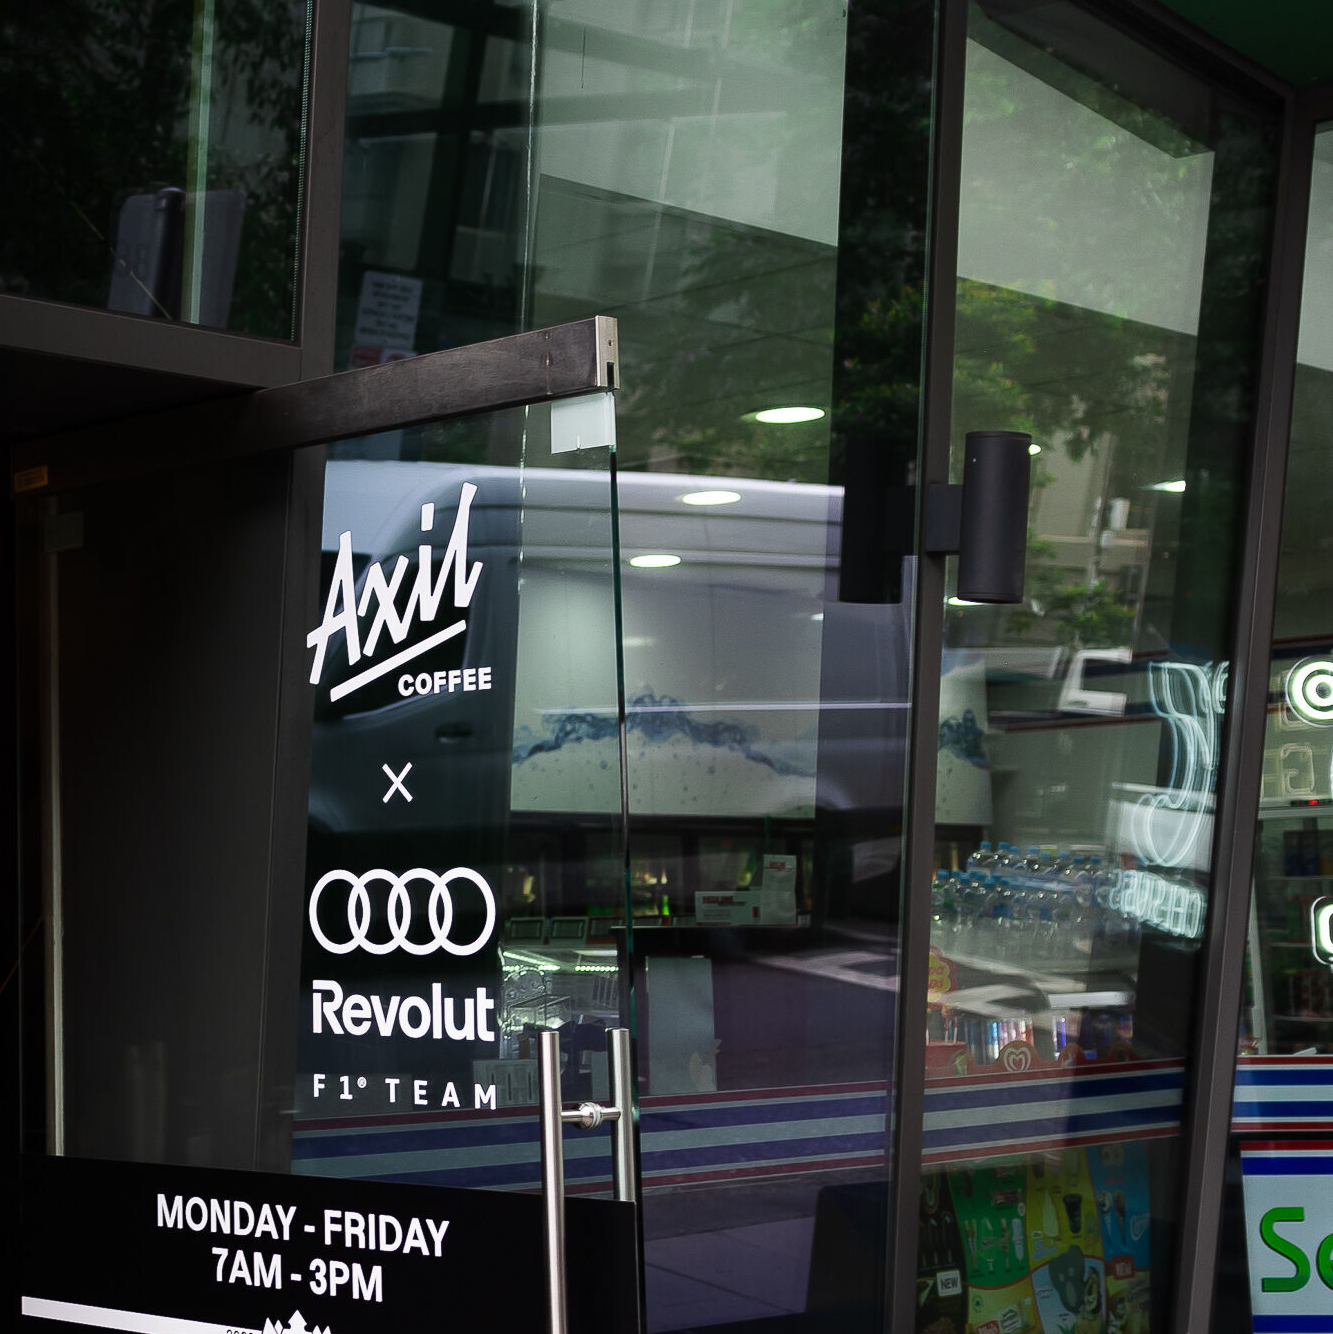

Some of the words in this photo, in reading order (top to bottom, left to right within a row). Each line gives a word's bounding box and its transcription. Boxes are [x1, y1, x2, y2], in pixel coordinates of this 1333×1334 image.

[307, 481, 483, 685] Axil
[397, 667, 492, 697] COFFEE
[312, 979, 495, 1042] Revolut
[384, 1077, 497, 1111] TEAM
[156, 1193, 297, 1241] MONDAY
[323, 1209, 451, 1257] FRIDAY
[211, 1246, 283, 1290] 7AM
[309, 1258, 384, 1303] 3PM
[940, 1276, 959, 1290] NEW
